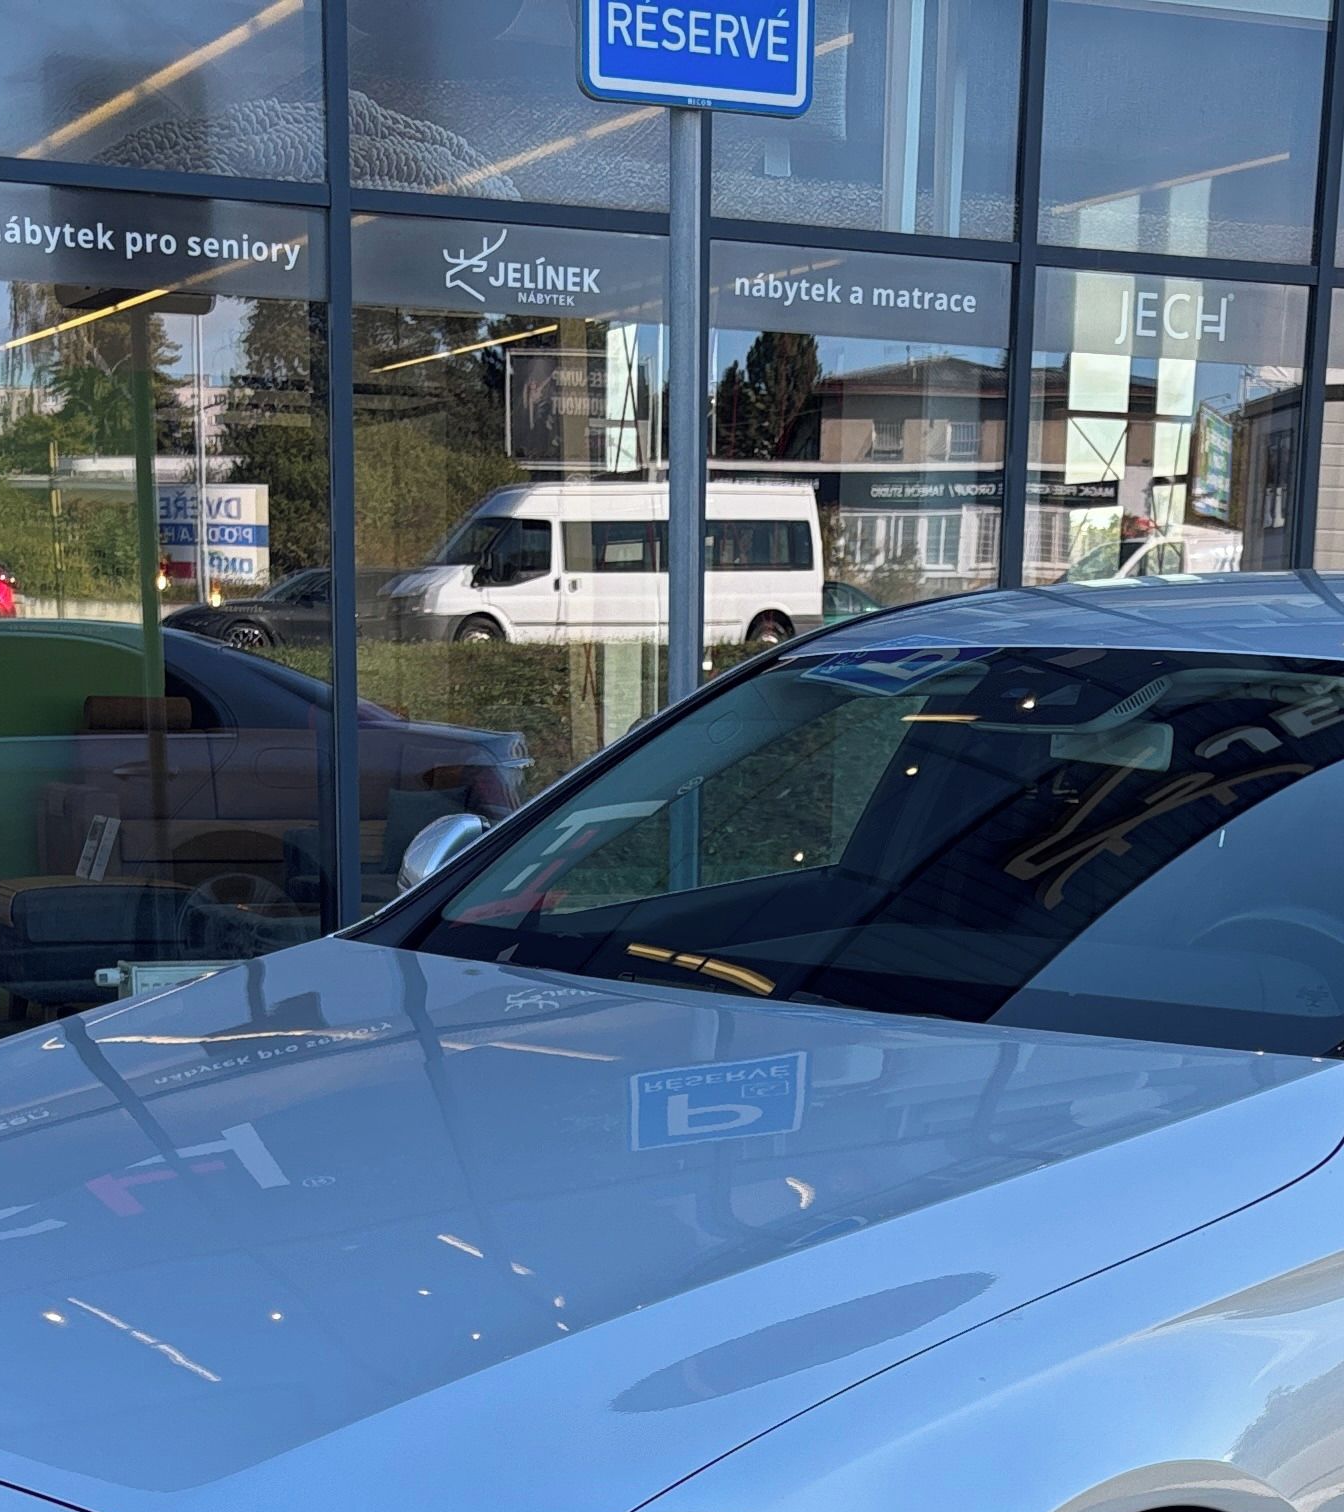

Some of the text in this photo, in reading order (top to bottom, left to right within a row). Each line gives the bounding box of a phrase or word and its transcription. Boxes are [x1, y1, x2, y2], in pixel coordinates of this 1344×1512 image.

[608, 0, 791, 63] RÉSERVÉ
[125, 230, 177, 260] pro
[186, 233, 301, 271] seniory
[488, 256, 601, 294] JELÍNEK
[734, 272, 977, 313] nábytek a matrace
[517, 290, 576, 307] NÁBYTEK
[1114, 289, 1228, 344] JECH
